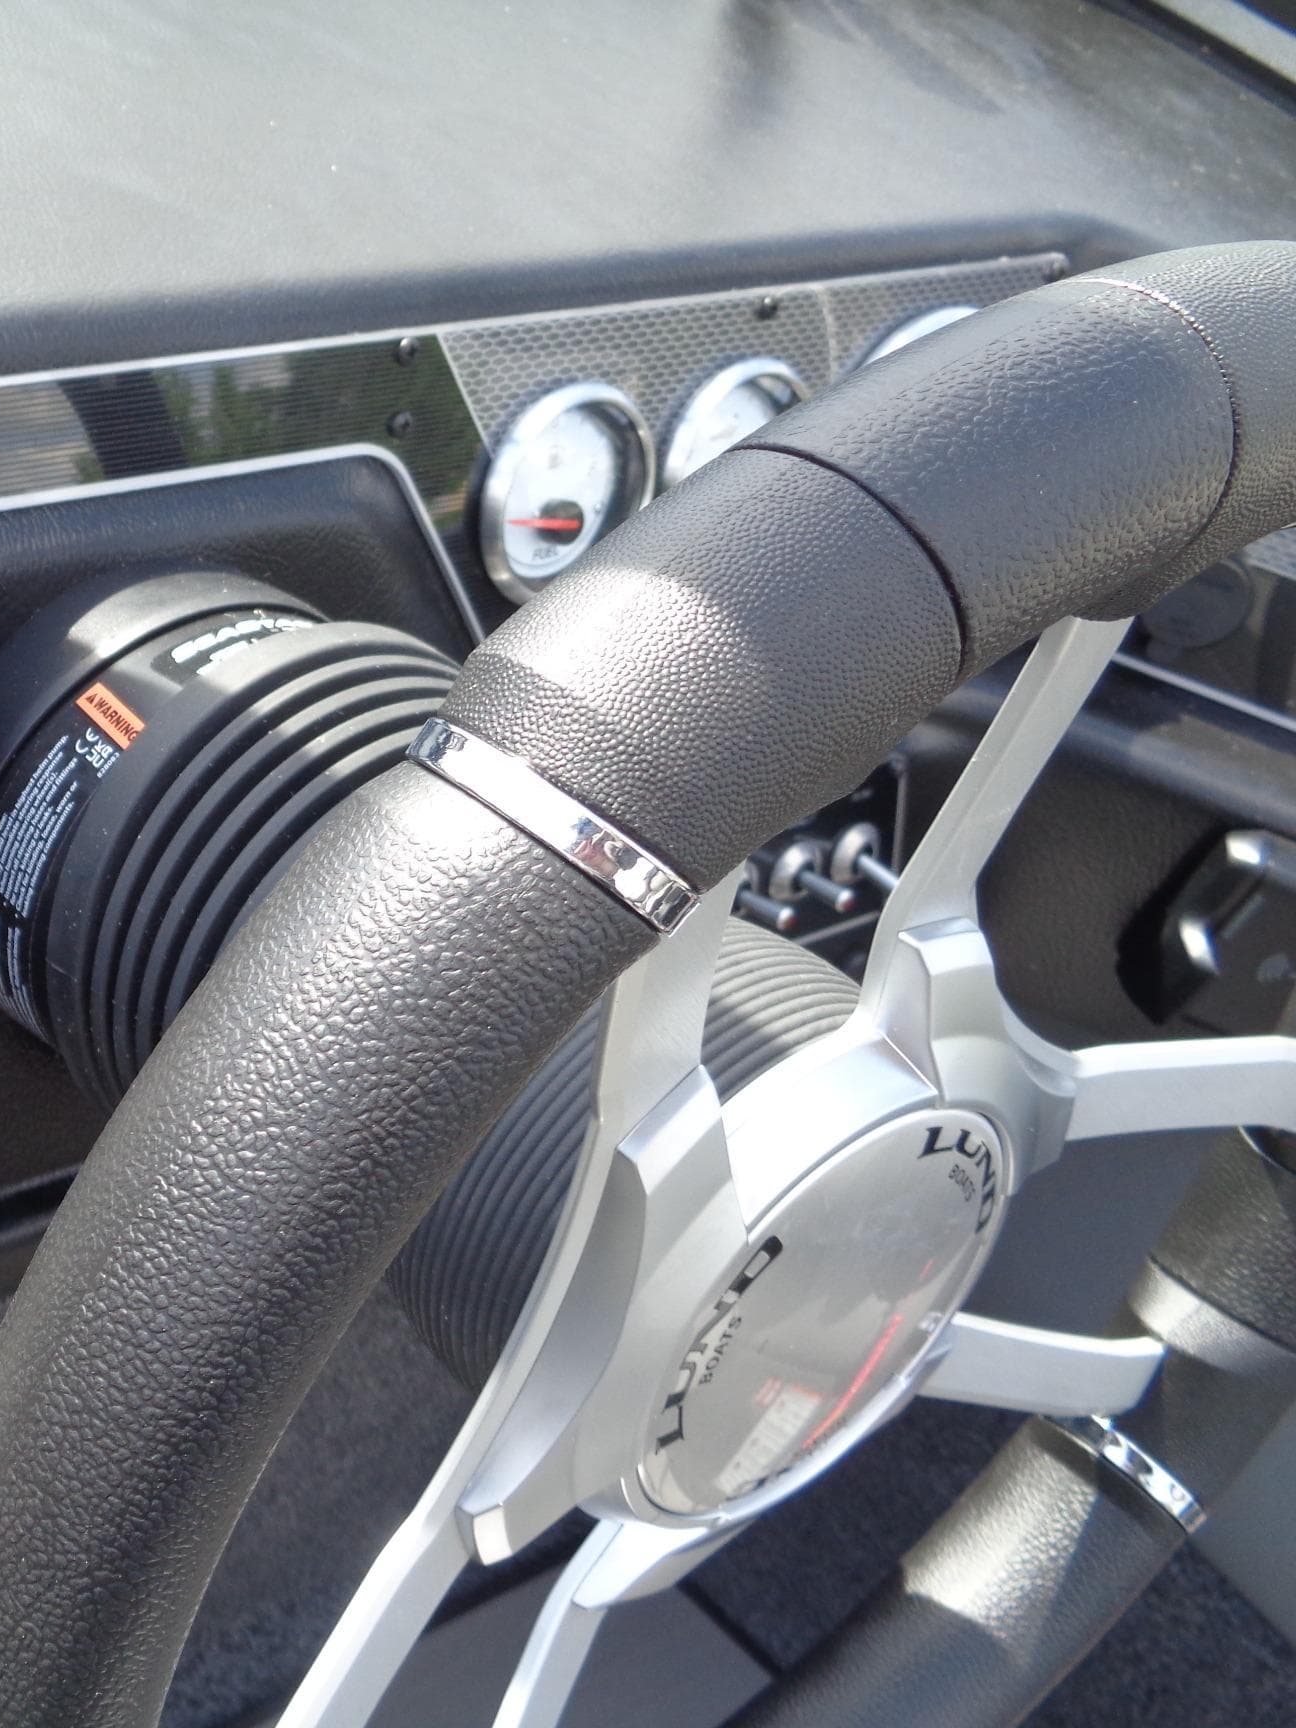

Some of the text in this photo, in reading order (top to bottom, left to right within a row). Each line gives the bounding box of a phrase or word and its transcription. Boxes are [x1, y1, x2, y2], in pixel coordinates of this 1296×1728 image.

[94, 697, 139, 741] WARNING
[31, 757, 50, 780] helm
[46, 733, 70, 761] pump.
[44, 783, 59, 803] and
[55, 790, 73, 814] worn
[917, 1126, 996, 1234] LUND
[948, 1164, 976, 1202] BOATS
[655, 1235, 783, 1455] LUND
[699, 1316, 742, 1386] BOATS
